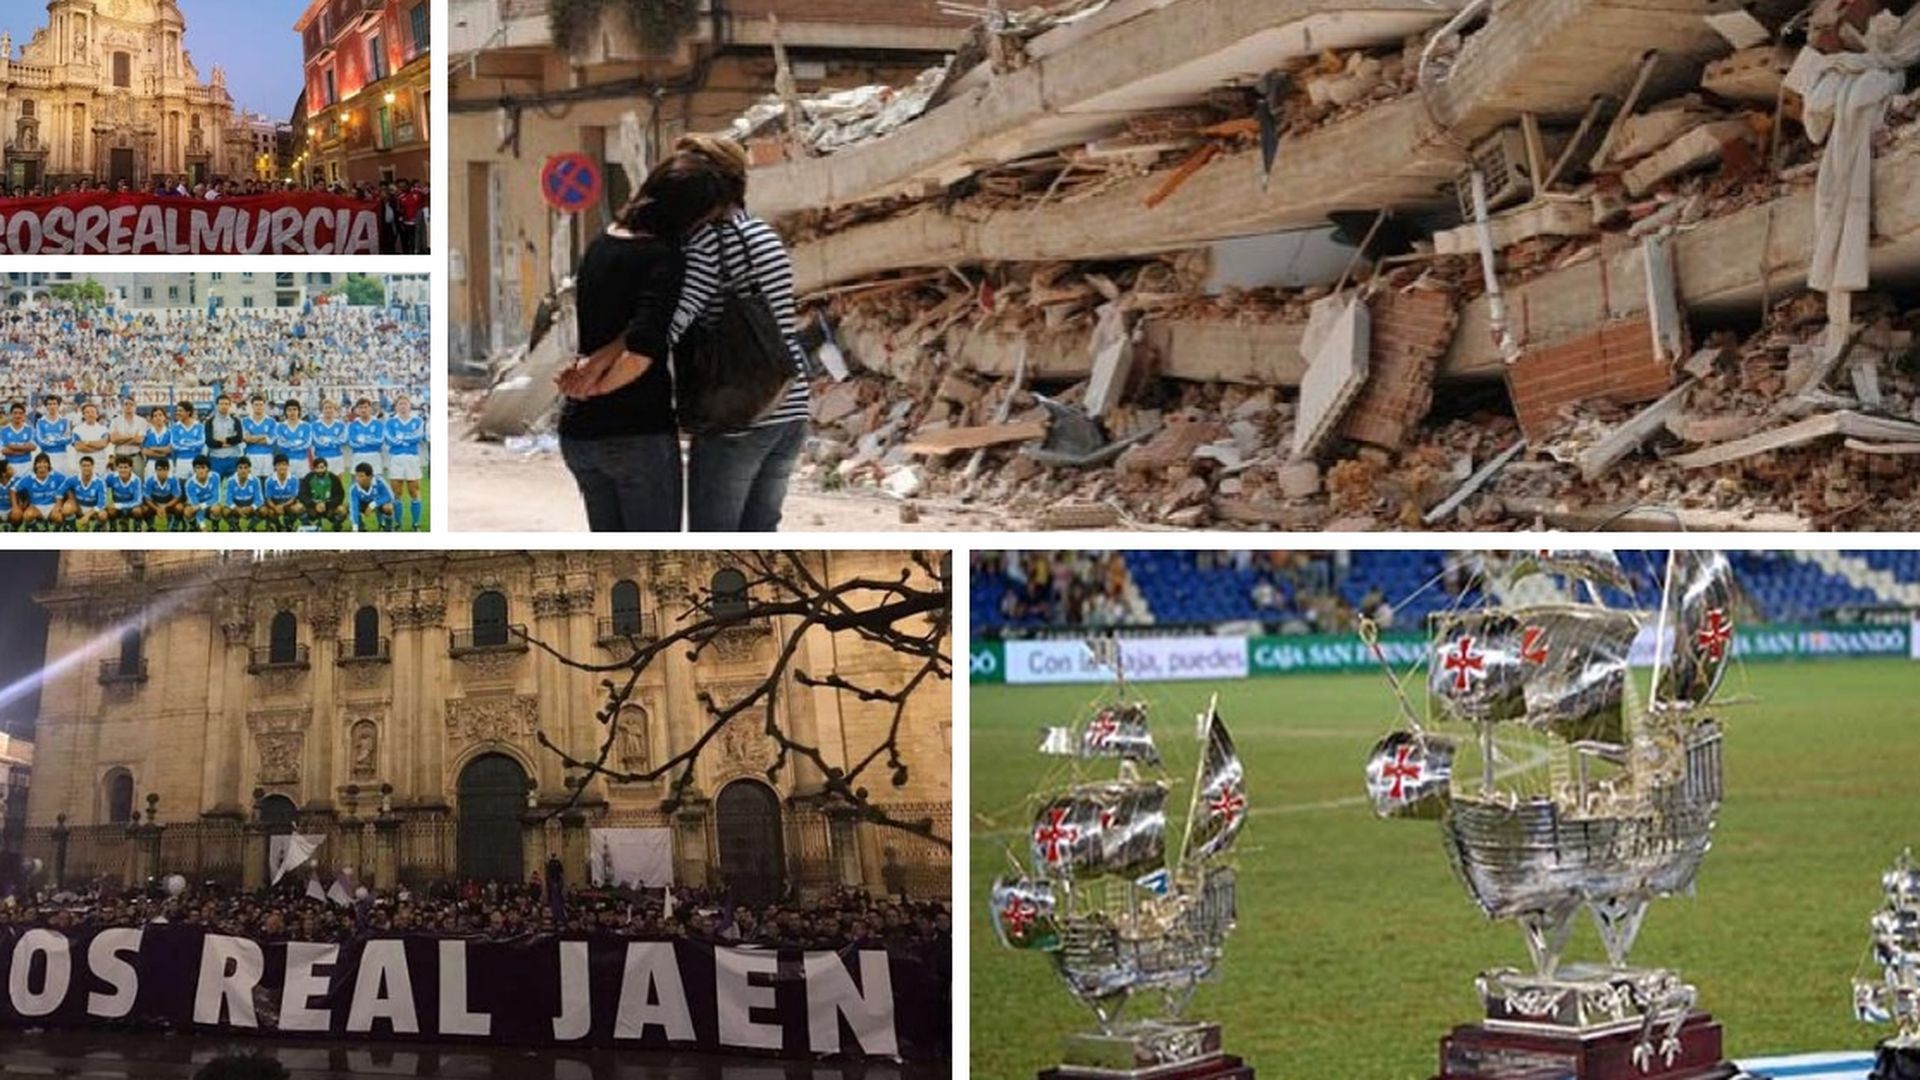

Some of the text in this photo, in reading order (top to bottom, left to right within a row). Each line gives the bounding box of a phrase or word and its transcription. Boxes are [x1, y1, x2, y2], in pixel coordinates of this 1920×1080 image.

[1028, 651, 1073, 674] Con
[1122, 649, 1163, 677] aja,
[1169, 647, 1243, 674] puedes
[1253, 642, 1306, 670] CAJA
[1308, 641, 1351, 666] SAN
[9, 927, 899, 1056] OS REAL JAEN
